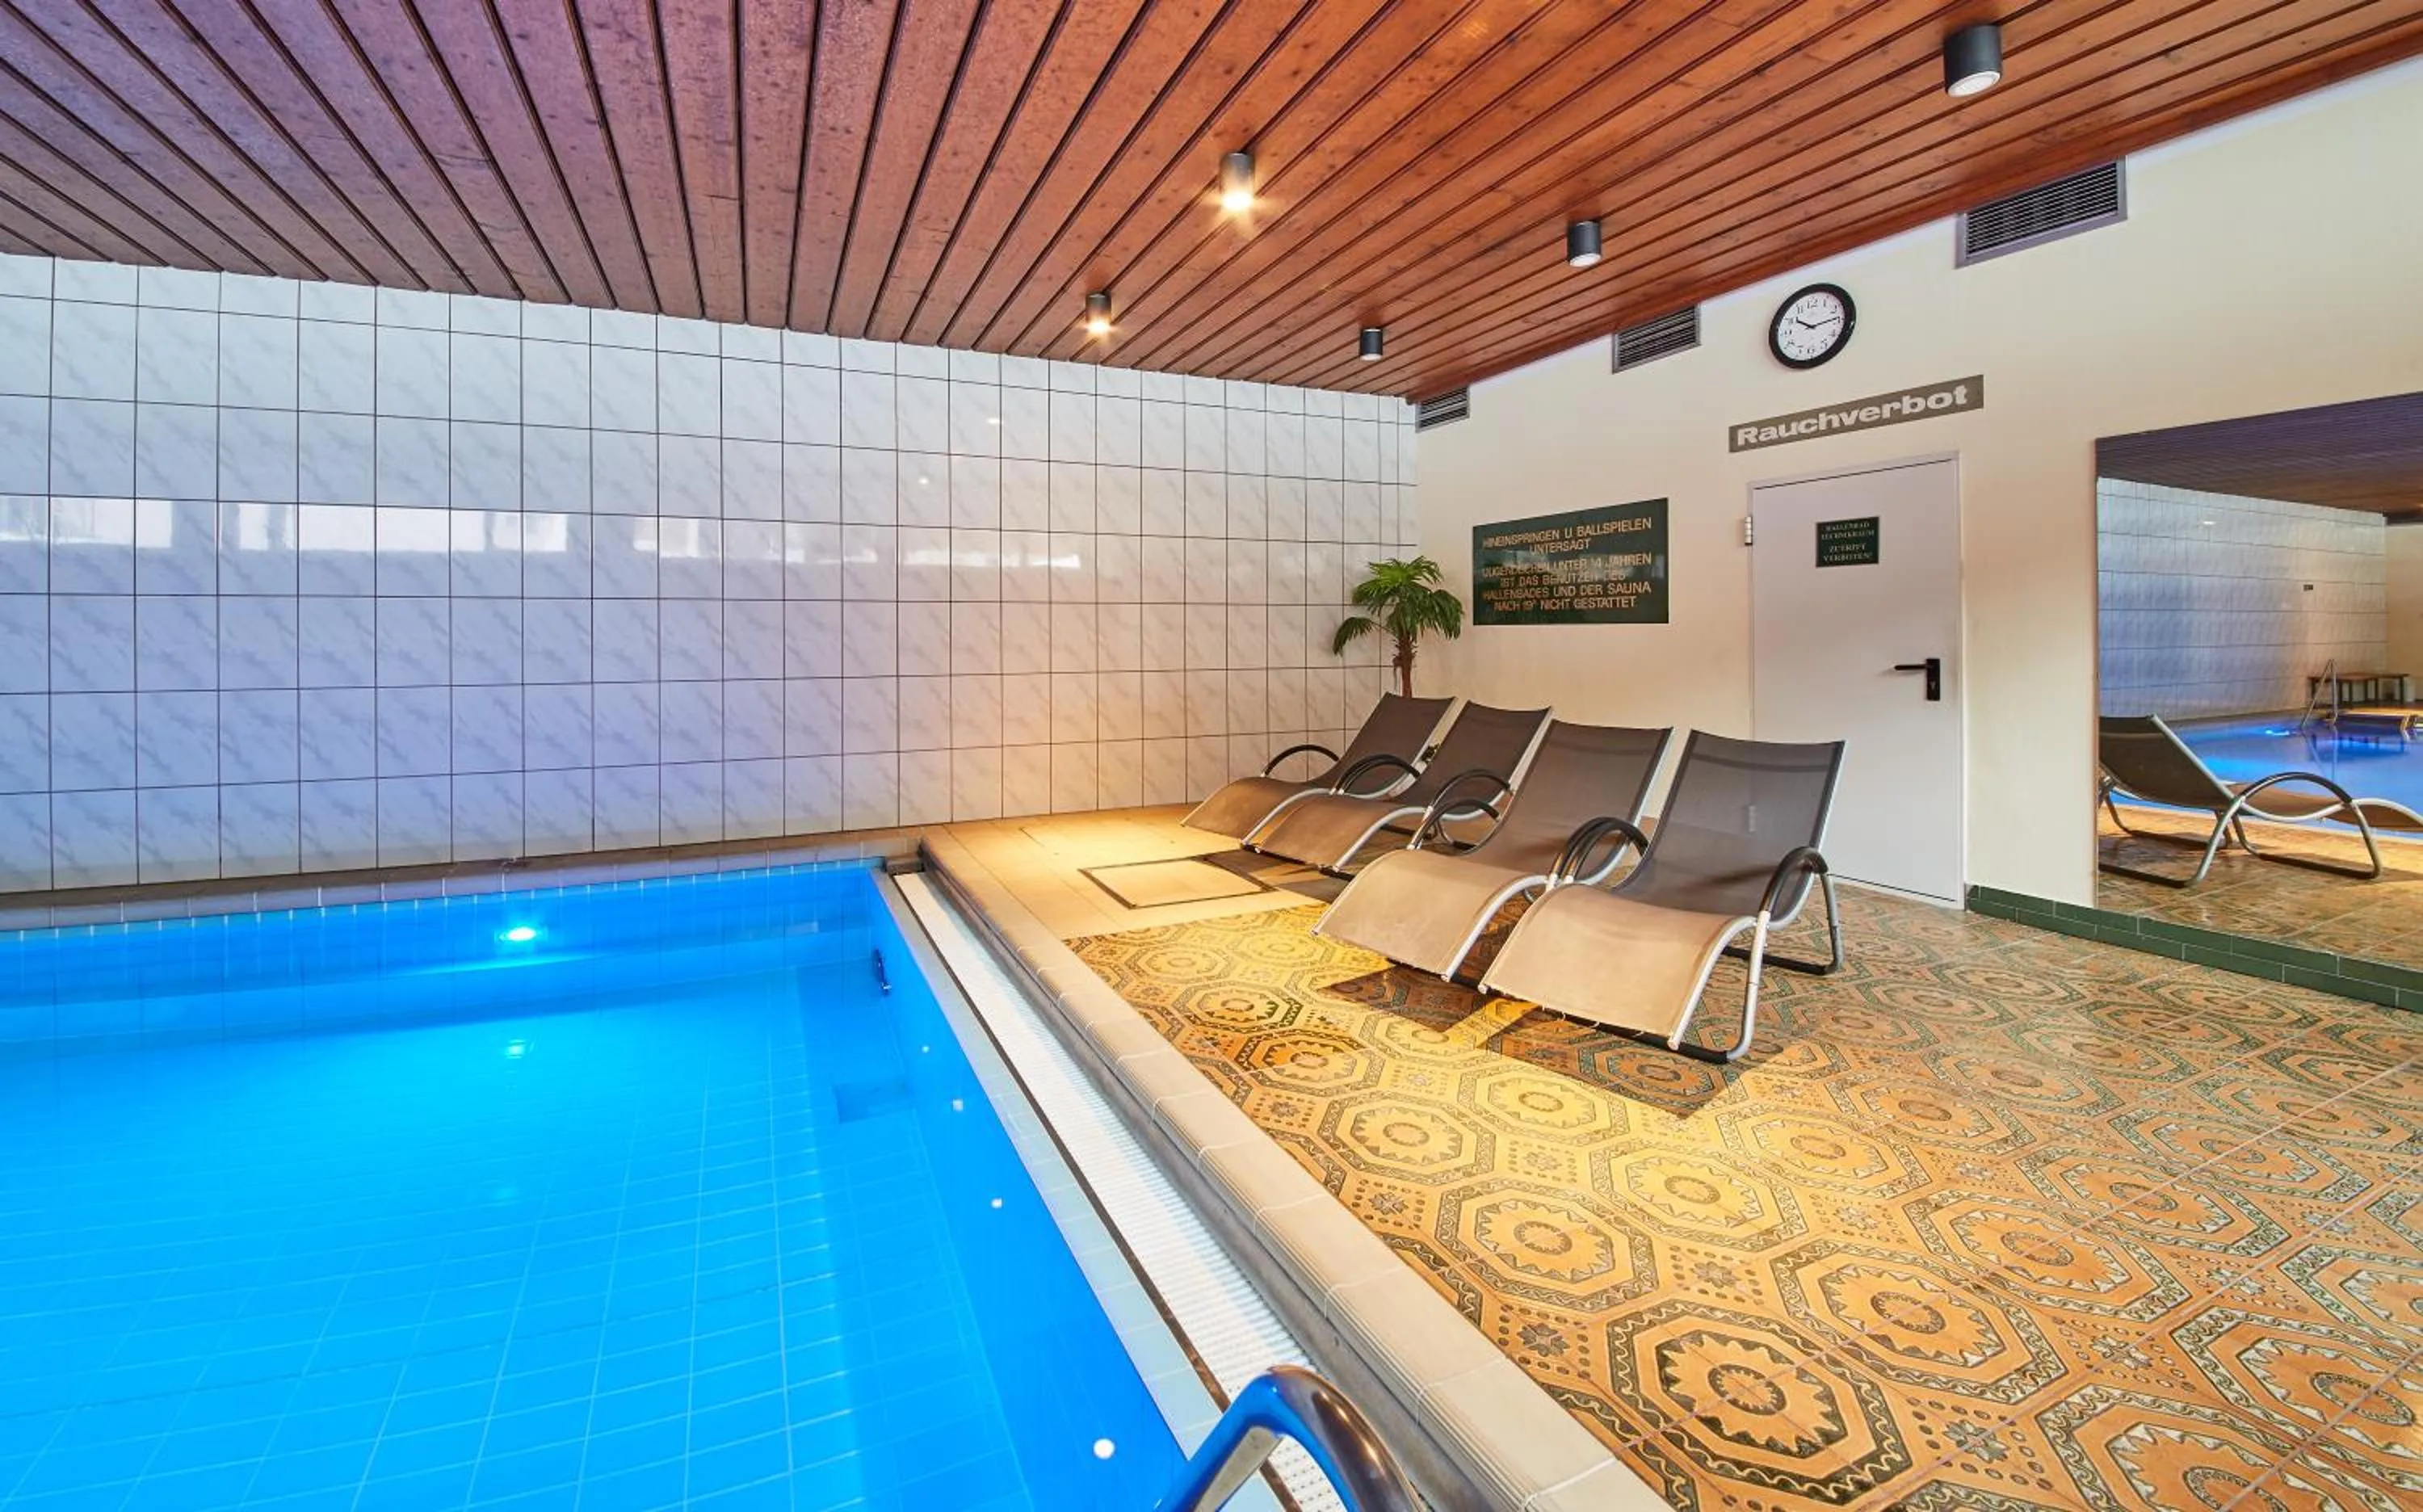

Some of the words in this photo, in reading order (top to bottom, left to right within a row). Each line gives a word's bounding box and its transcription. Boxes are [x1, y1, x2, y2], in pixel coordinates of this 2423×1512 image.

[1736, 384, 1968, 447] Rauchverbot
[1577, 516, 1652, 537] BALLSPIELEN
[1529, 538, 1591, 556] UNTERSAGT
[1552, 558, 1587, 571] UNTER
[1605, 552, 1652, 569] JAHREN
[1519, 574, 1539, 587] DAS
[1553, 586, 1576, 598] UND
[1580, 584, 1604, 596] DER
[1607, 581, 1652, 595] SAUNA
[1540, 597, 1571, 611] NICHT
